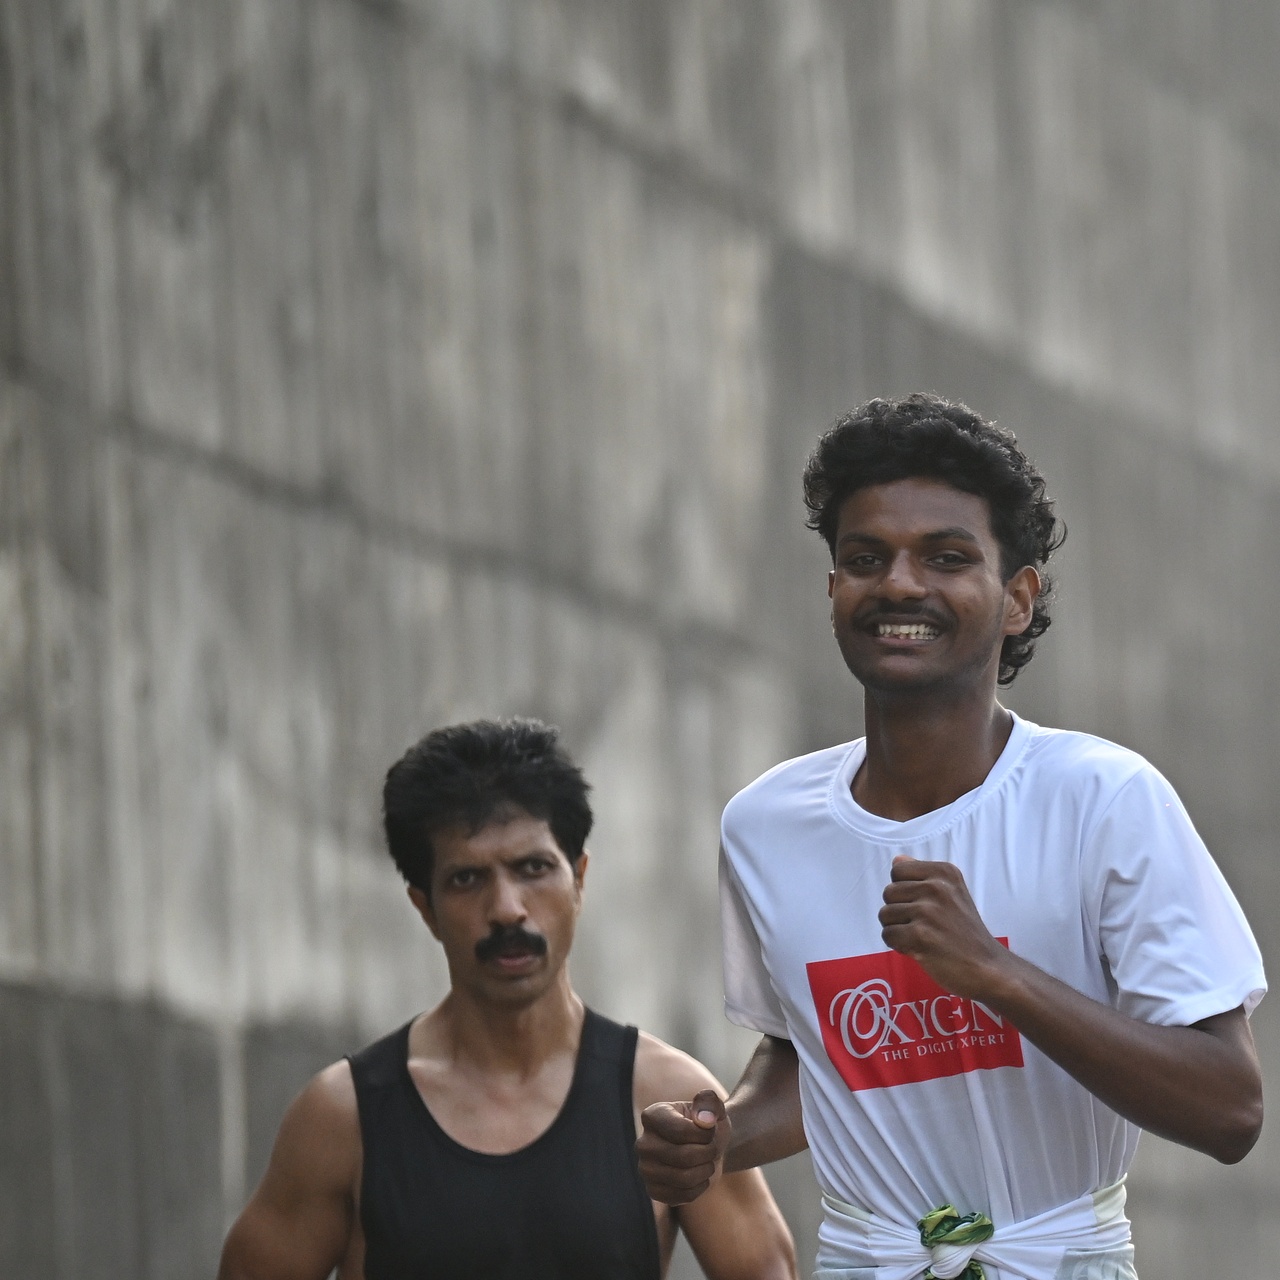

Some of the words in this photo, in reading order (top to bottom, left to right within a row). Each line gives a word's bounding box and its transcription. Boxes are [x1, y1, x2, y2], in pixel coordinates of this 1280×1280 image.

[881, 1048, 910, 1062] THE
[916, 1039, 955, 1057] DIGIT
[959, 1033, 1006, 1049] XPERT
